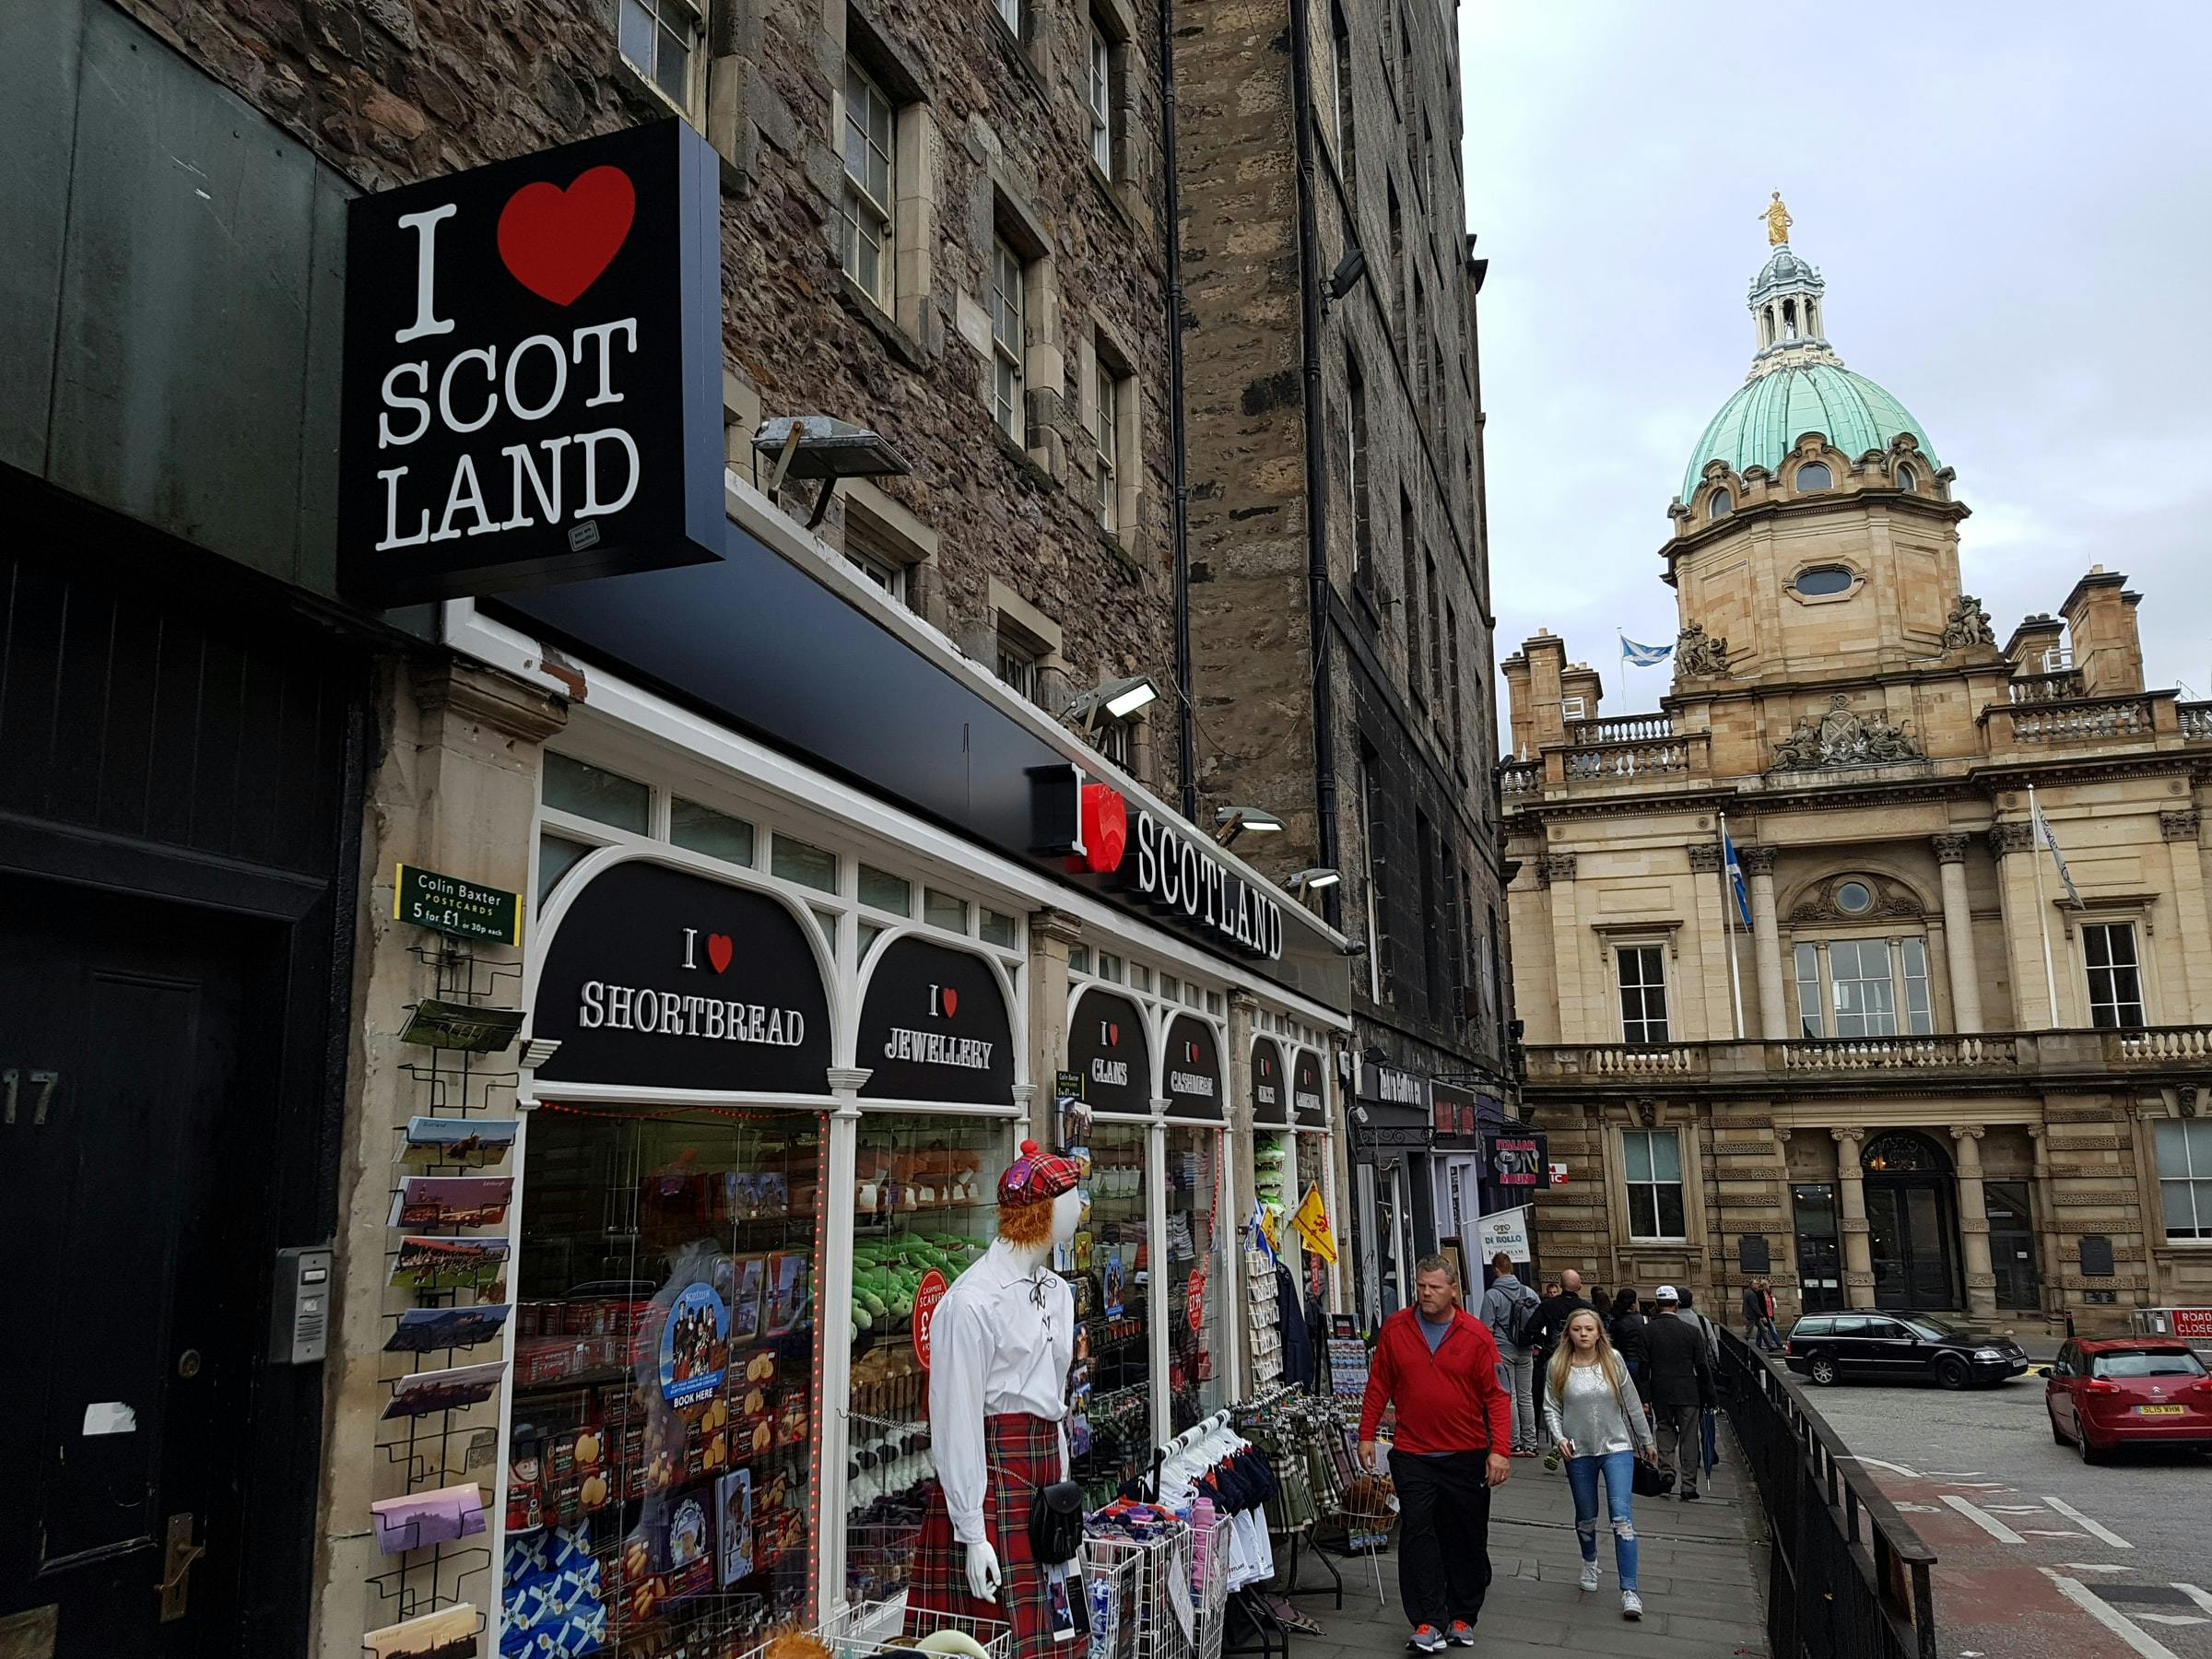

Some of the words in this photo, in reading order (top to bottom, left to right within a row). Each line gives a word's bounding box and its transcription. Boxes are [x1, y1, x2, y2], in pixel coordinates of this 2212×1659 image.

[395, 203, 457, 344] I
[379, 317, 638, 449] SCOT
[375, 428, 641, 552] LAND
[1071, 762, 1088, 856] I
[1138, 810, 1283, 961] SCOTLAND
[418, 875, 454, 895] Colin
[458, 885, 501, 906] Baxter
[425, 893, 493, 916] POSTCARDS
[413, 902, 423, 918] 5
[426, 911, 440, 922] for
[443, 910, 459, 926] £1
[471, 924, 487, 934] 30p
[681, 927, 698, 970] I
[579, 981, 805, 1048] SHORTBREAD
[928, 983, 939, 1018] I
[884, 1027, 994, 1070] JEWELLERY
[1100, 1020, 1108, 1046] I
[1184, 1041, 1191, 1063] I
[1091, 1058, 1127, 1086] CLANS
[3, 1068, 59, 1124] 17
[2182, 1312, 2212, 1322] ROAD
[674, 1392, 695, 1408] BOOK
[696, 1387, 713, 1402] HERE
